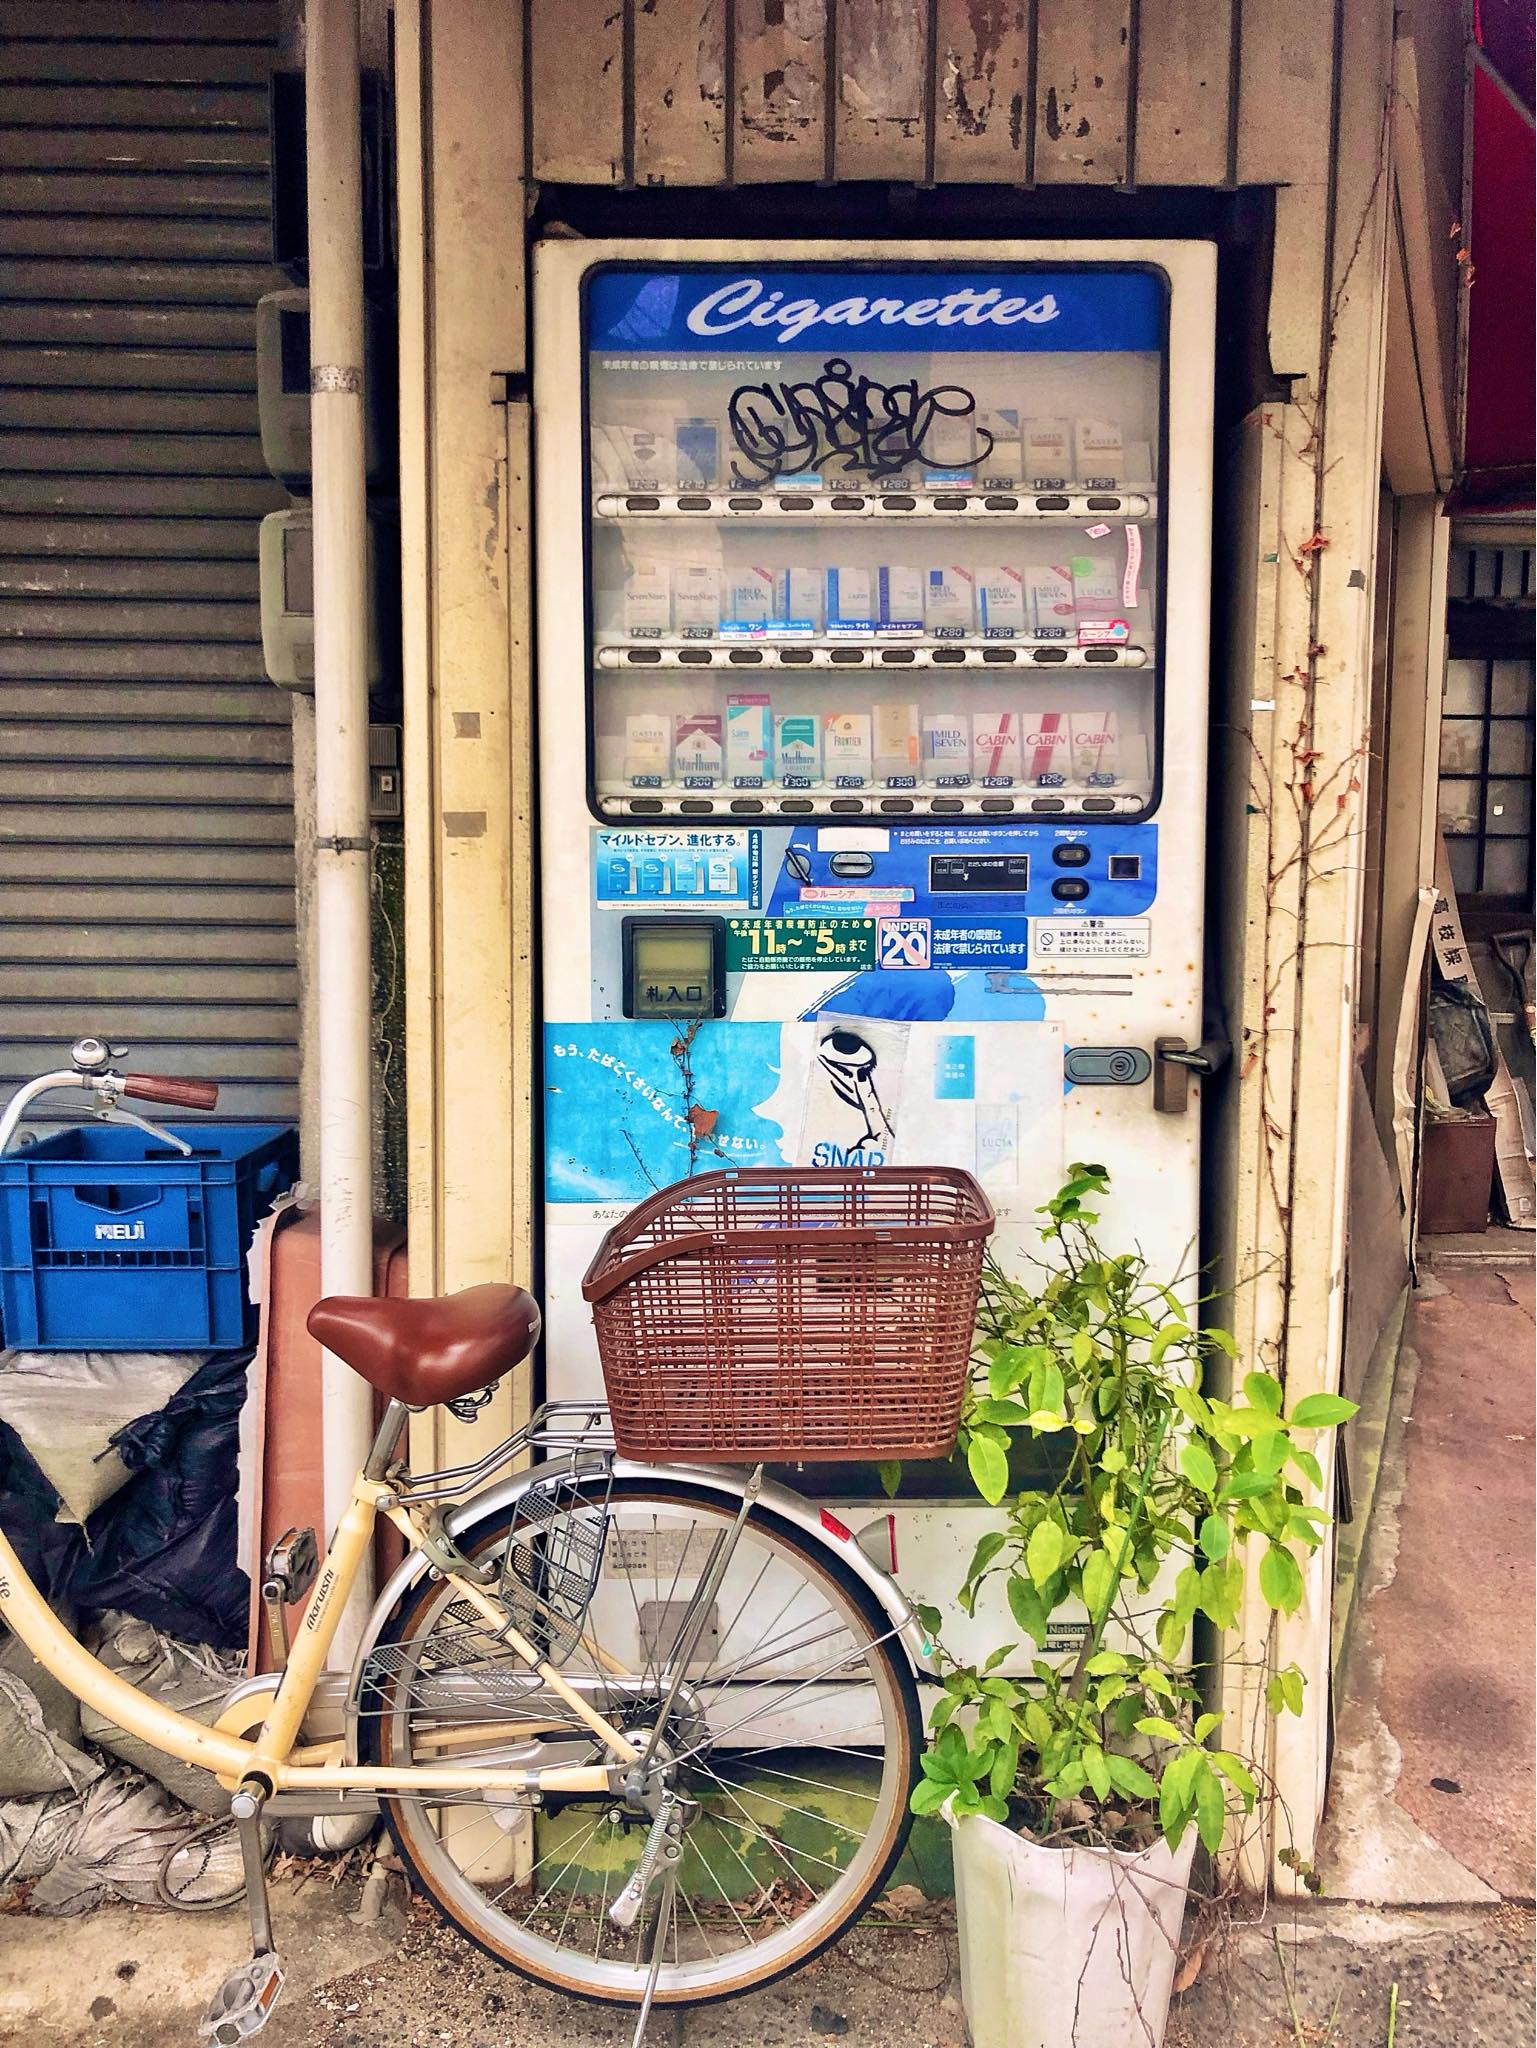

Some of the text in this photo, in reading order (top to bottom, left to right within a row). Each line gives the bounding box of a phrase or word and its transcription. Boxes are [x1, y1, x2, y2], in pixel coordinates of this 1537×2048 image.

[686, 278, 1061, 343] Cigarettes
[937, 628, 963, 636] ¥280
[986, 628, 1012, 637] ¥280
[1037, 629, 1062, 637] ¥280
[935, 738, 967, 747] SEVEN
[976, 734, 1017, 746] CABIN
[1026, 734, 1067, 746] CABIN
[1075, 732, 1116, 746] CABIN
[677, 753, 720, 771] Marlboro
[781, 751, 815, 764] Marlboro
[686, 777, 711, 786] ¥300
[735, 777, 761, 786] ¥300
[784, 777, 808, 787] ¥300
[889, 777, 914, 787] ¥300
[984, 776, 1010, 786] ¥280
[600, 833, 741, 847] マイルドセブン、進化する。
[820, 890, 856, 899] ルーシア
[882, 922, 927, 932] UNDER
[933, 930, 1002, 940] 未成年者の喫煙は
[882, 931, 928, 966] 20
[933, 943, 1026, 954] 法律で禁じられています
[646, 985, 702, 1002] 札入口
